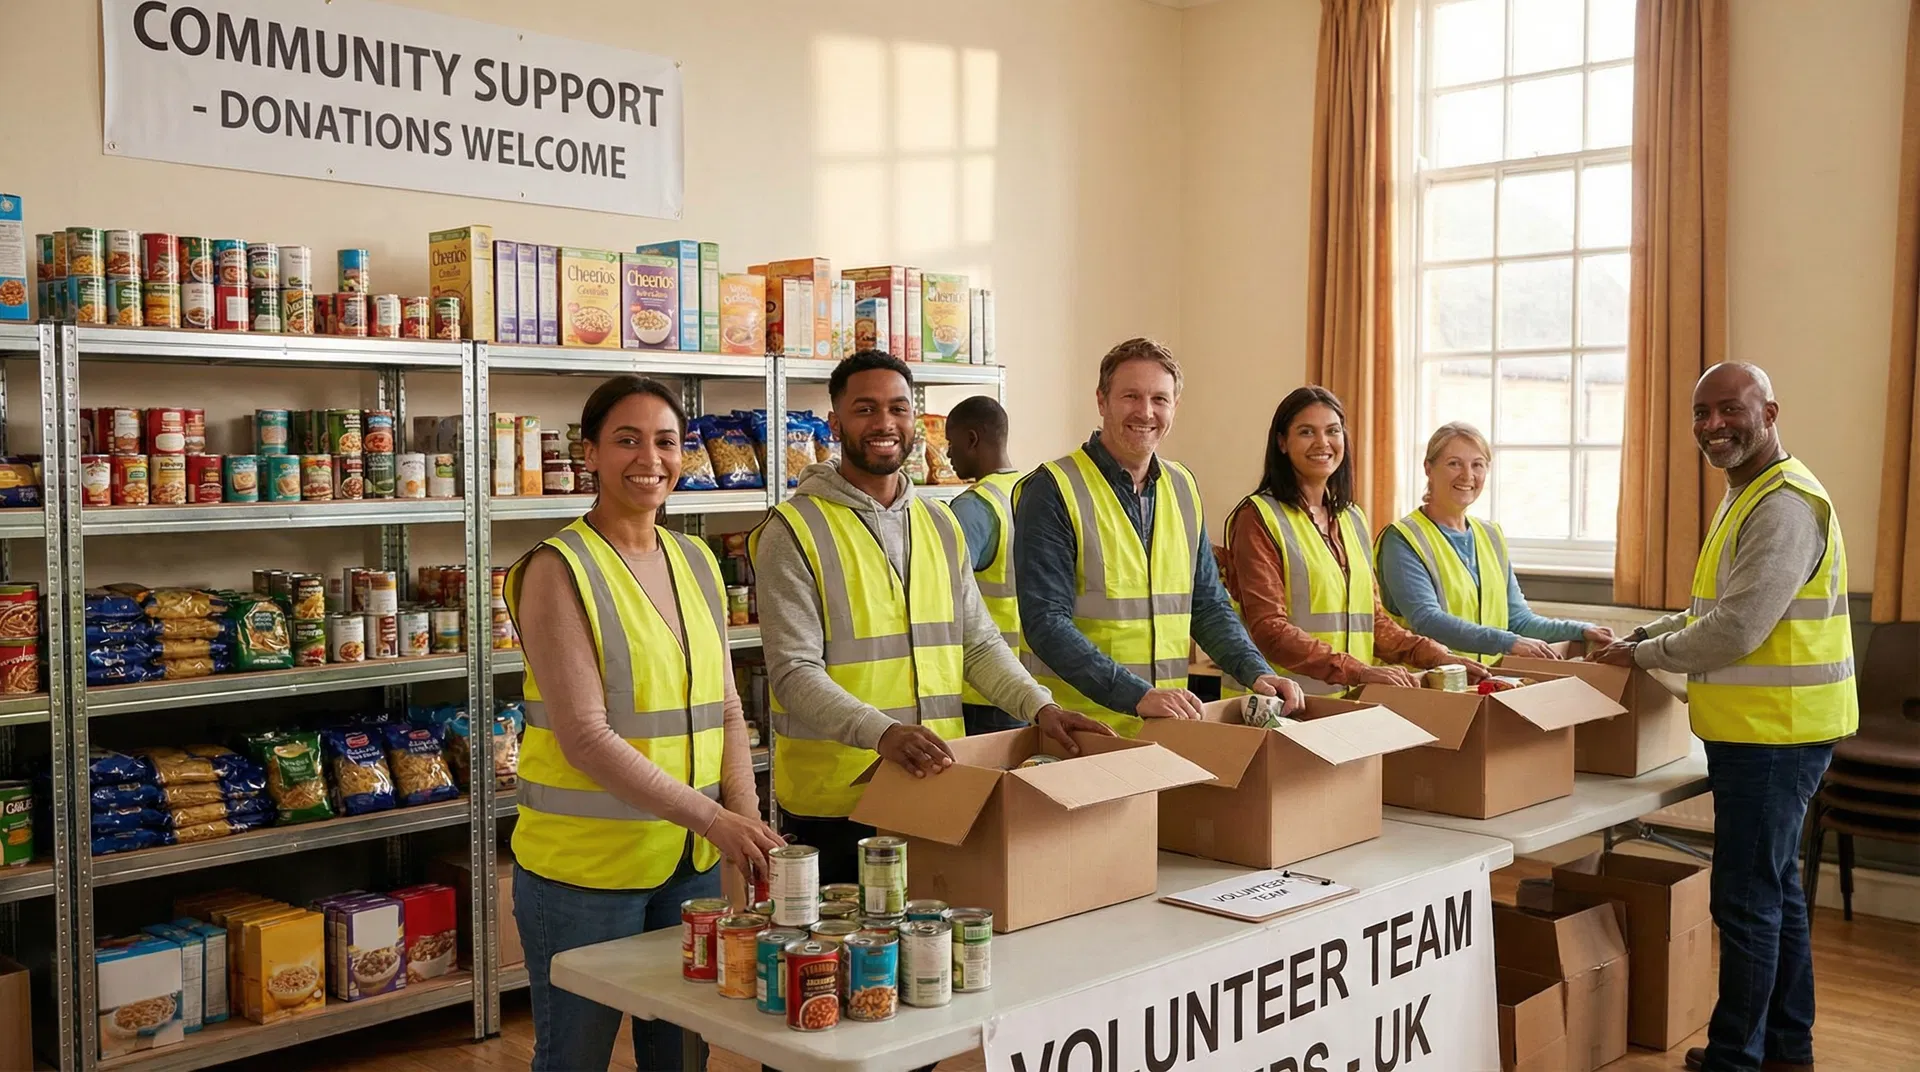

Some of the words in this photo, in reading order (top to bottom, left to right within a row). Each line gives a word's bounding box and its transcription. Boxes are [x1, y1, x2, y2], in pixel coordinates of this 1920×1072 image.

[133, 0, 462, 96] COMMUNITY
[474, 58, 664, 127] SUPPORT
[220, 89, 452, 157] DONATIONS
[461, 124, 626, 179] WELCOME
[567, 264, 616, 285] Cheerios
[627, 269, 675, 290] Cheerios
[1212, 878, 1291, 903] VOLUNTEER
[1250, 888, 1291, 902] TEAM
[1363, 889, 1473, 987] TEAM
[1375, 993, 1432, 1072] UK
